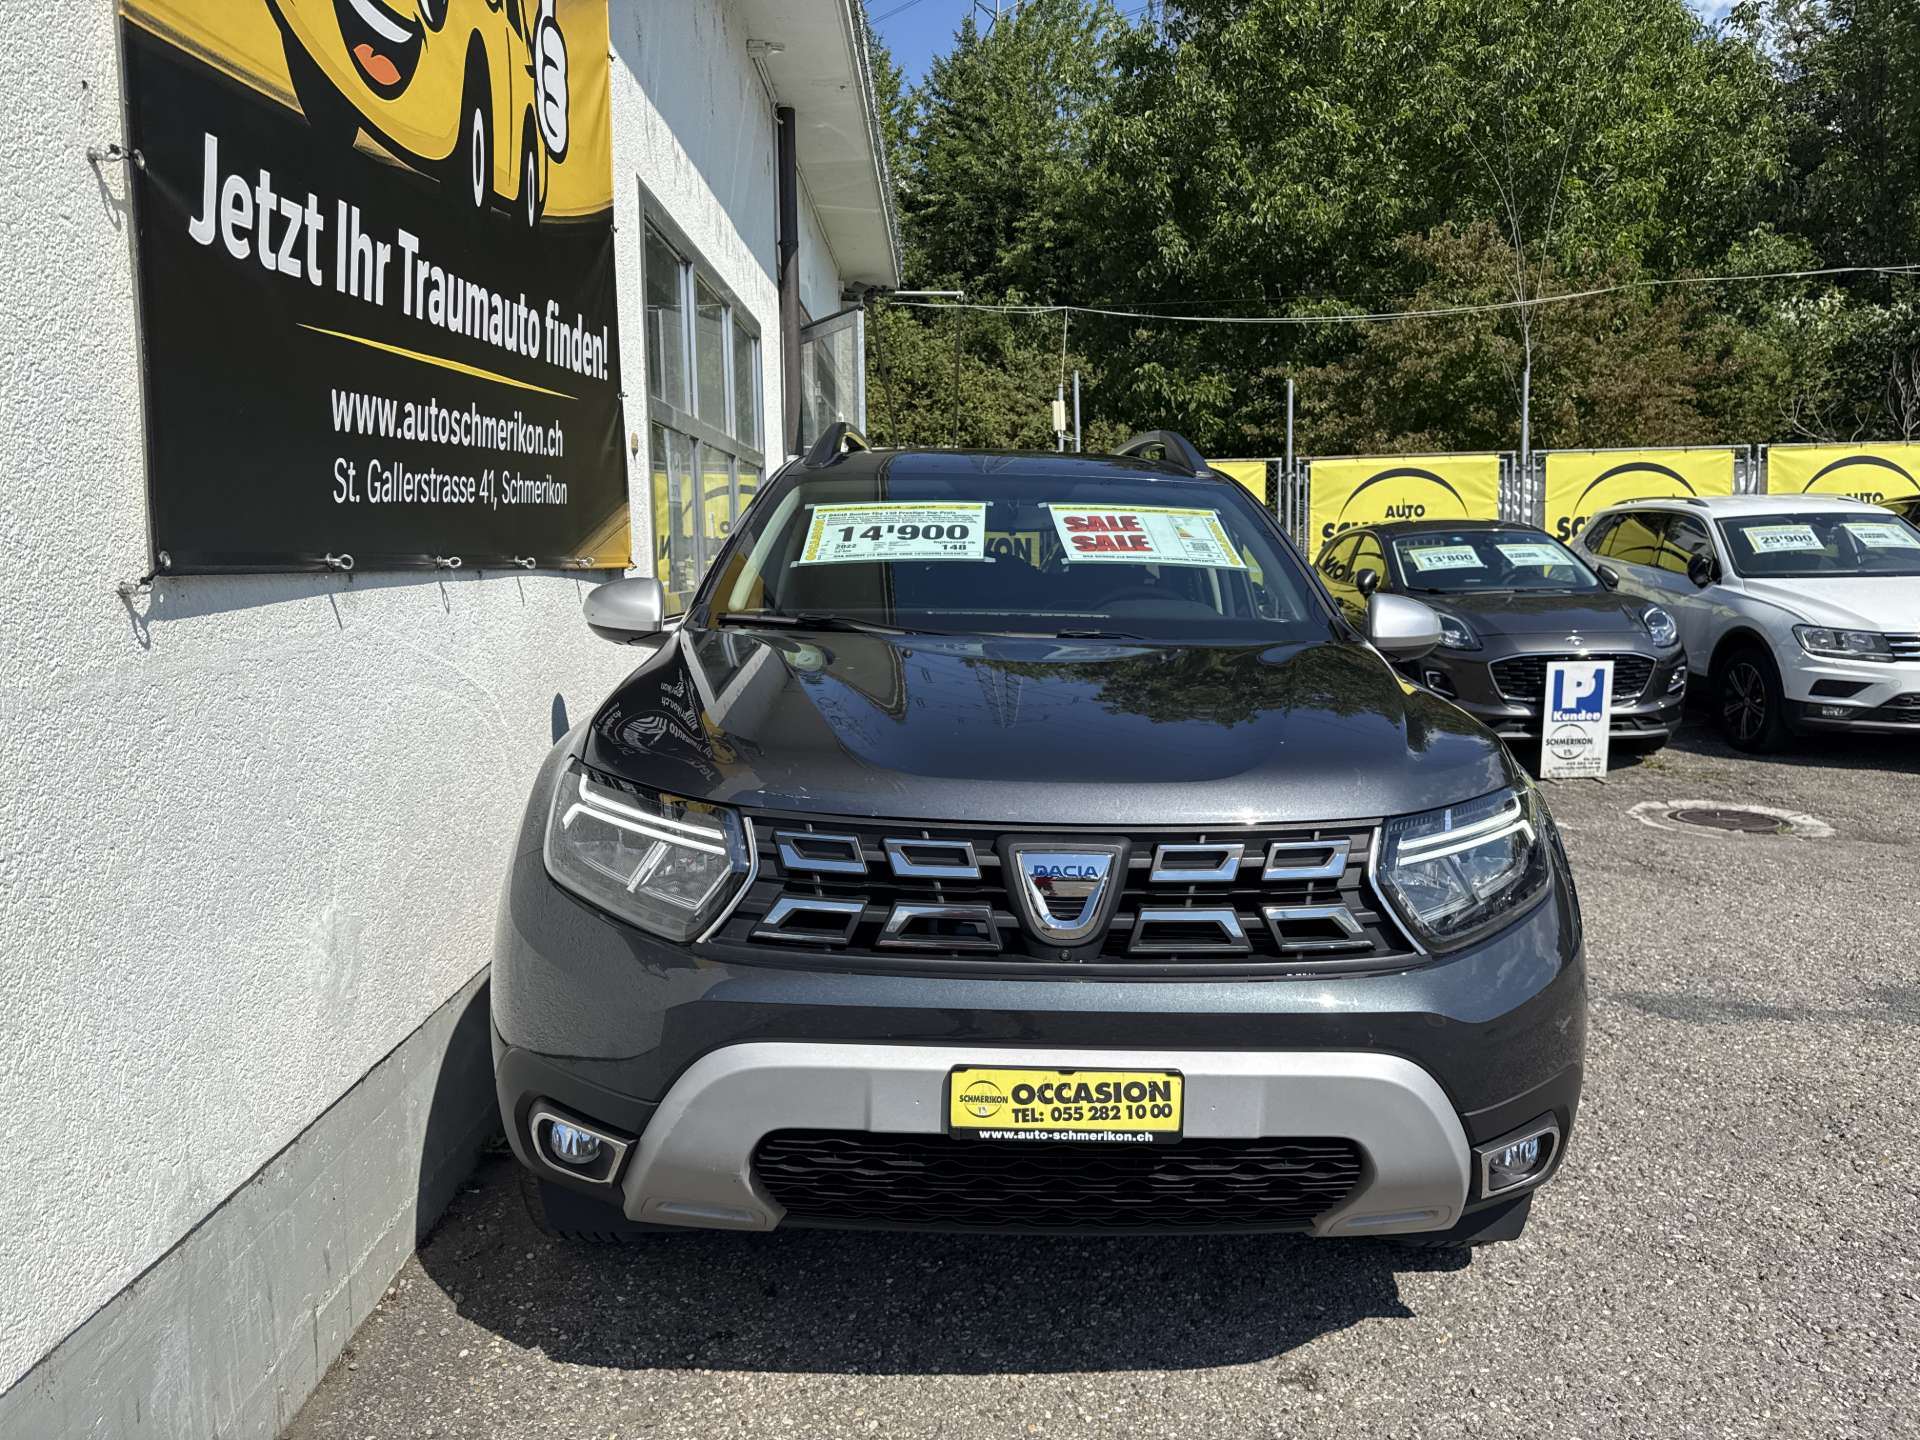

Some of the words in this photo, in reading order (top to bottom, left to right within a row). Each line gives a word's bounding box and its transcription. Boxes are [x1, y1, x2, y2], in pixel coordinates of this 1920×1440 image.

[187, 132, 324, 287] Jetzt
[336, 199, 392, 307] Ihr
[398, 228, 541, 359] Traumauto
[545, 299, 609, 382] finden!
[331, 388, 564, 458] www.autoschmerikon.ch
[333, 457, 361, 504] St.
[367, 458, 477, 504] Gallerstrasse
[479, 468, 499, 512] 41,
[501, 470, 568, 505] Schmerikon
[1385, 504, 1426, 519] AUTO
[837, 524, 970, 542] 14'900
[1063, 515, 1144, 533] SALE
[1070, 534, 1154, 552] SALE
[1760, 534, 1813, 546] 25'900
[1425, 554, 1474, 564] 13'800
[1561, 668, 1597, 709] P
[1552, 709, 1601, 721] Kunden
[1033, 865, 1098, 878] DACIA
[959, 1094, 1009, 1105] SCHMERIKON
[1011, 1080, 1172, 1106] OCCASION
[1012, 1108, 1045, 1123] TEL:
[1050, 1106, 1085, 1122] 055
[1088, 1104, 1122, 1121] 282
[1126, 1104, 1147, 1120] 10
[1150, 1103, 1174, 1119] 00
[979, 1129, 1154, 1143] www.auto-schmerikon.ch
